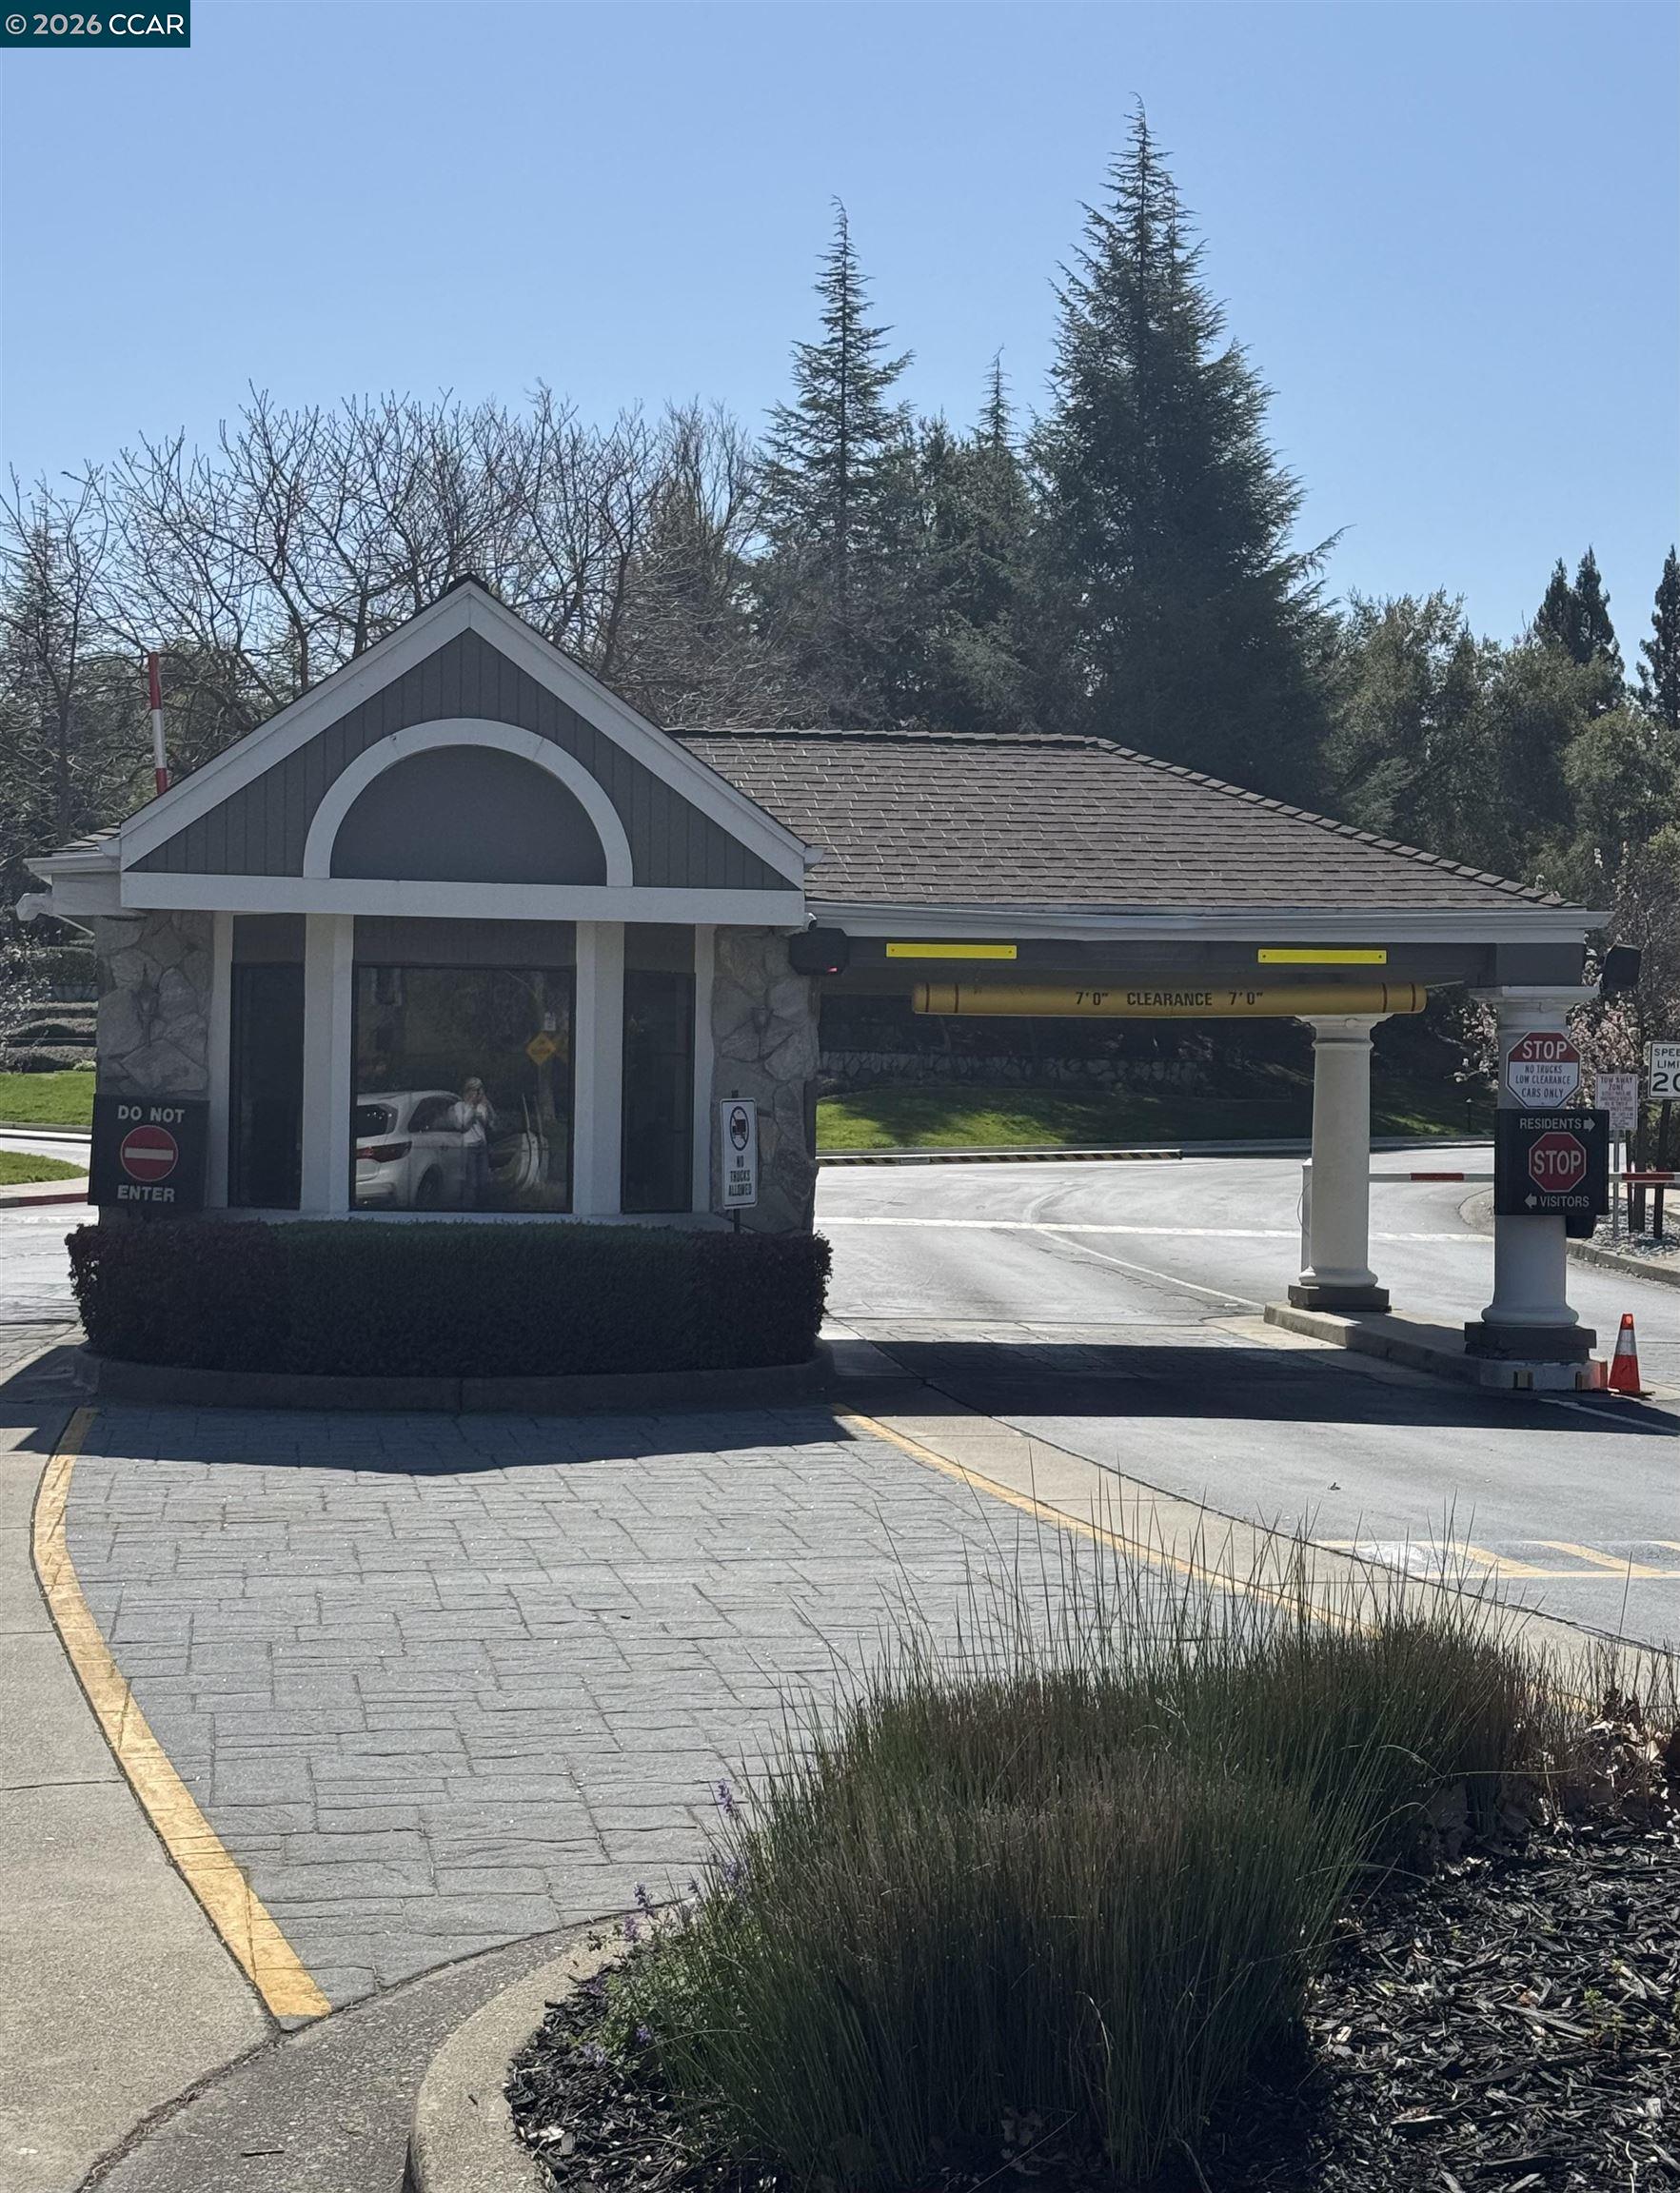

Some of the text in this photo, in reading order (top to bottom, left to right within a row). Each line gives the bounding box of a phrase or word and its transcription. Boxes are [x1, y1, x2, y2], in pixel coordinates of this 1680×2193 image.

[1127, 992, 1213, 1007] CLEARANCE
[1522, 1040, 1567, 1059] STOP
[1525, 1064, 1563, 1074] NO TRUCKS
[1515, 1075, 1571, 1085] LOW CLEARANCE
[1521, 1088, 1564, 1098] CARS ONLY
[117, 1105, 185, 1123] DO NOT
[1519, 1117, 1582, 1130] RESIDENTS
[1533, 1150, 1582, 1175] STOP
[117, 1184, 175, 1202] ENTER
[1540, 1195, 1590, 1207] VISITORS
